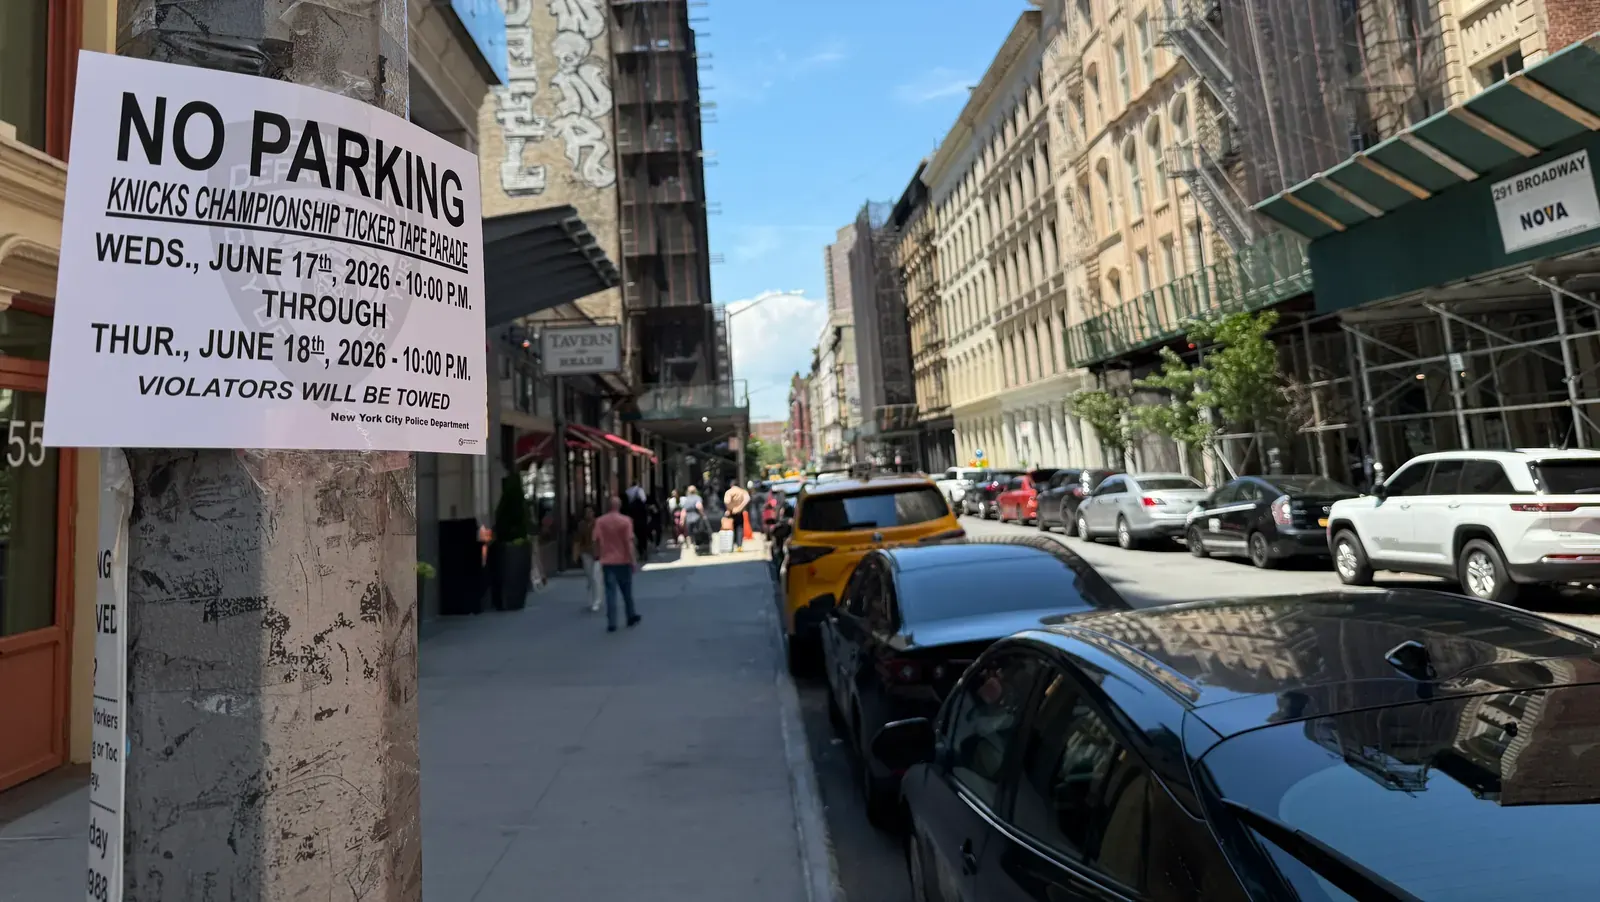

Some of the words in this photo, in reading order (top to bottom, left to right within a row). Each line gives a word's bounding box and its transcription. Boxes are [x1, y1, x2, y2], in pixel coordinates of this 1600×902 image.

[117, 91, 225, 171] NO
[250, 109, 465, 228] PARKING
[1493, 184, 1512, 200] 291
[1516, 155, 1586, 193] BROADWAY
[107, 176, 190, 216] KNICKS
[195, 185, 341, 234] CHAMPIONSHIP
[345, 206, 396, 247] TICKER
[400, 220, 427, 255] TAPE
[429, 230, 469, 269] PARADE
[1520, 201, 1569, 231] NOVA
[96, 232, 199, 275] WEDS.,
[209, 242, 283, 276] JUNE
[344, 258, 390, 291] 2026
[406, 270, 443, 303] 10:00
[447, 281, 472, 311] P.M.
[261, 289, 387, 329] THROUGH
[91, 322, 189, 363] THUR.,
[199, 329, 275, 361] JUNE
[337, 338, 386, 369] 2026
[403, 345, 442, 377] 10:00
[445, 353, 471, 381] P.M.
[549, 333, 613, 348] TAVERN
[138, 375, 294, 400] VIOLATORS
[302, 381, 357, 403] WILL
[362, 385, 392, 405] BE
[398, 387, 451, 410] TOWED
[330, 412, 356, 422] New
[359, 413, 383, 423] York
[385, 414, 403, 426] City
[405, 415, 429, 426] Police
[430, 418, 470, 431] Department
[7, 420, 45, 467] 55
[93, 706, 118, 730] Yorkers
[97, 743, 104, 757] or
[89, 816, 108, 860] day
